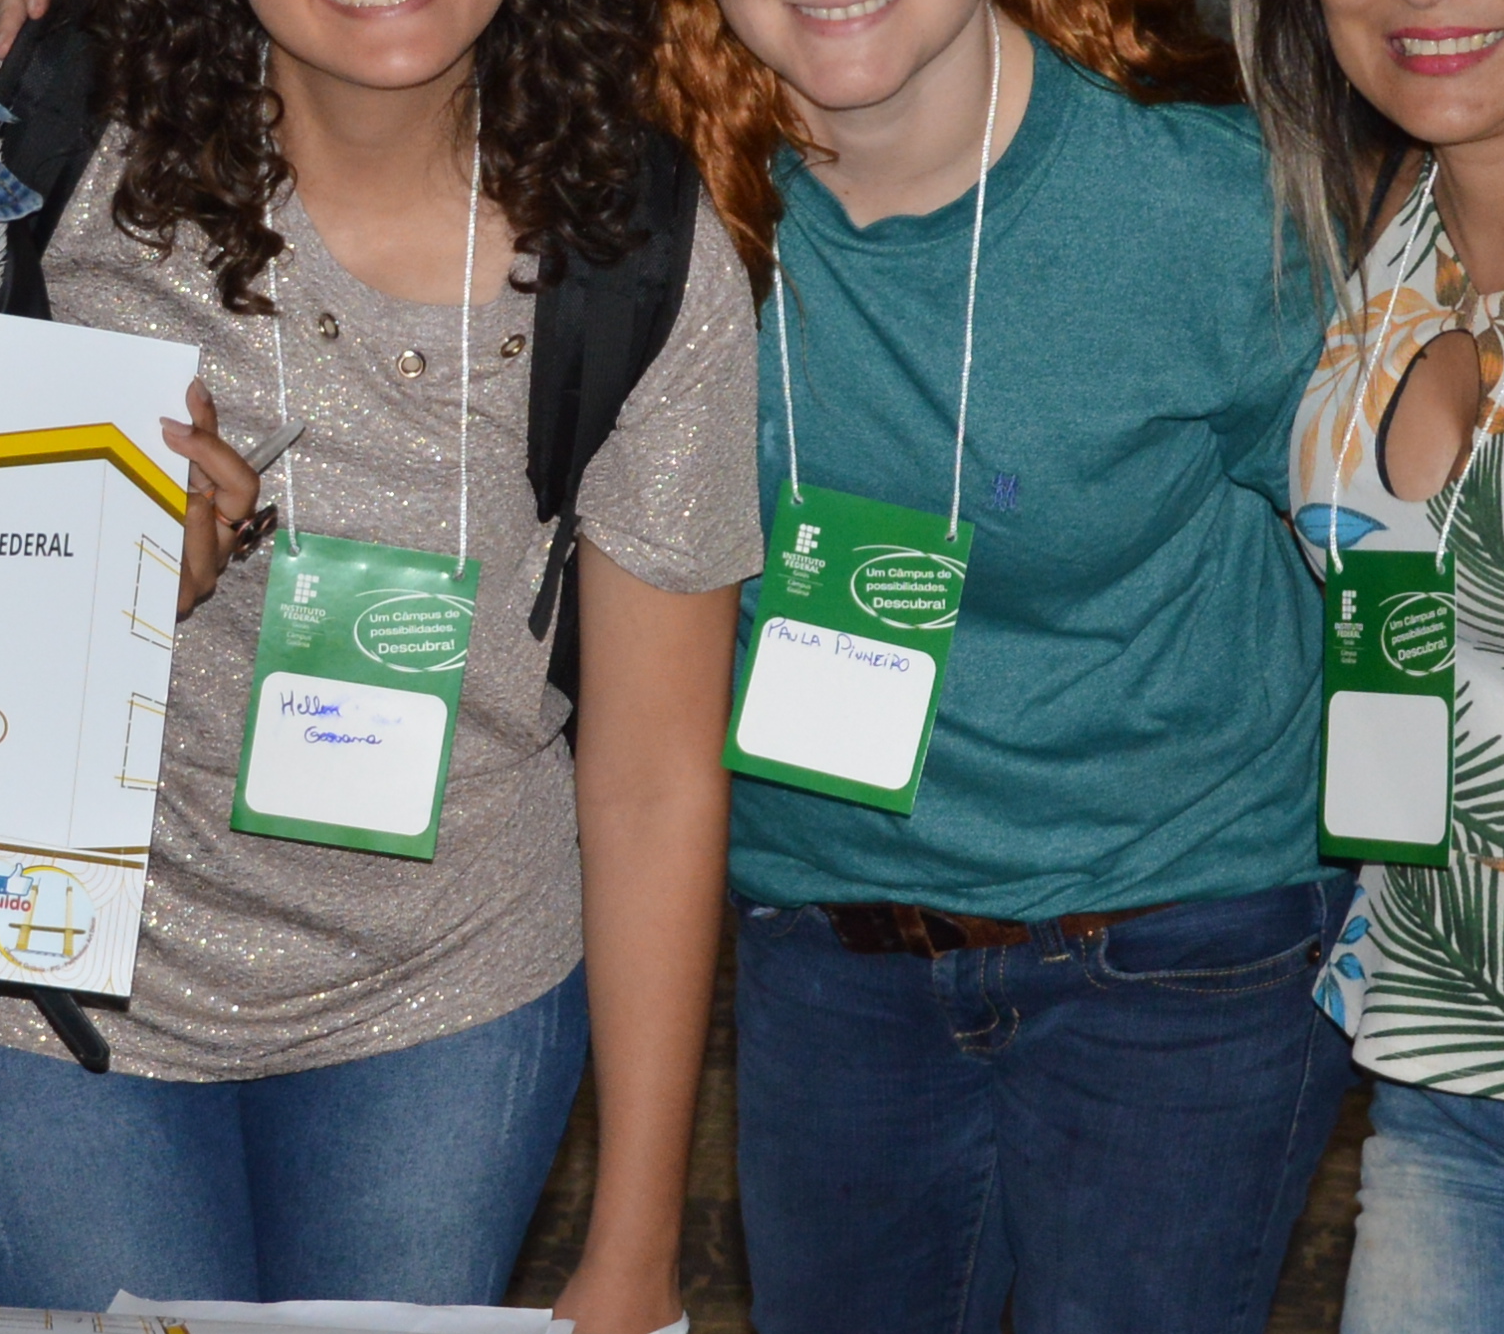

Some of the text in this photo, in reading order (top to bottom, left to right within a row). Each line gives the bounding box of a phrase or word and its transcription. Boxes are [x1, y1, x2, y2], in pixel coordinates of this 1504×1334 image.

[866, 568, 952, 580] Um Câmpus de
[866, 581, 948, 593] possibilidades.
[873, 597, 946, 610] Descubra!
[369, 610, 460, 624] Um Câmpus de
[370, 623, 457, 638] possibilidades.
[378, 639, 455, 654] Descubra!
[1397, 636, 1448, 661] Descubra!
